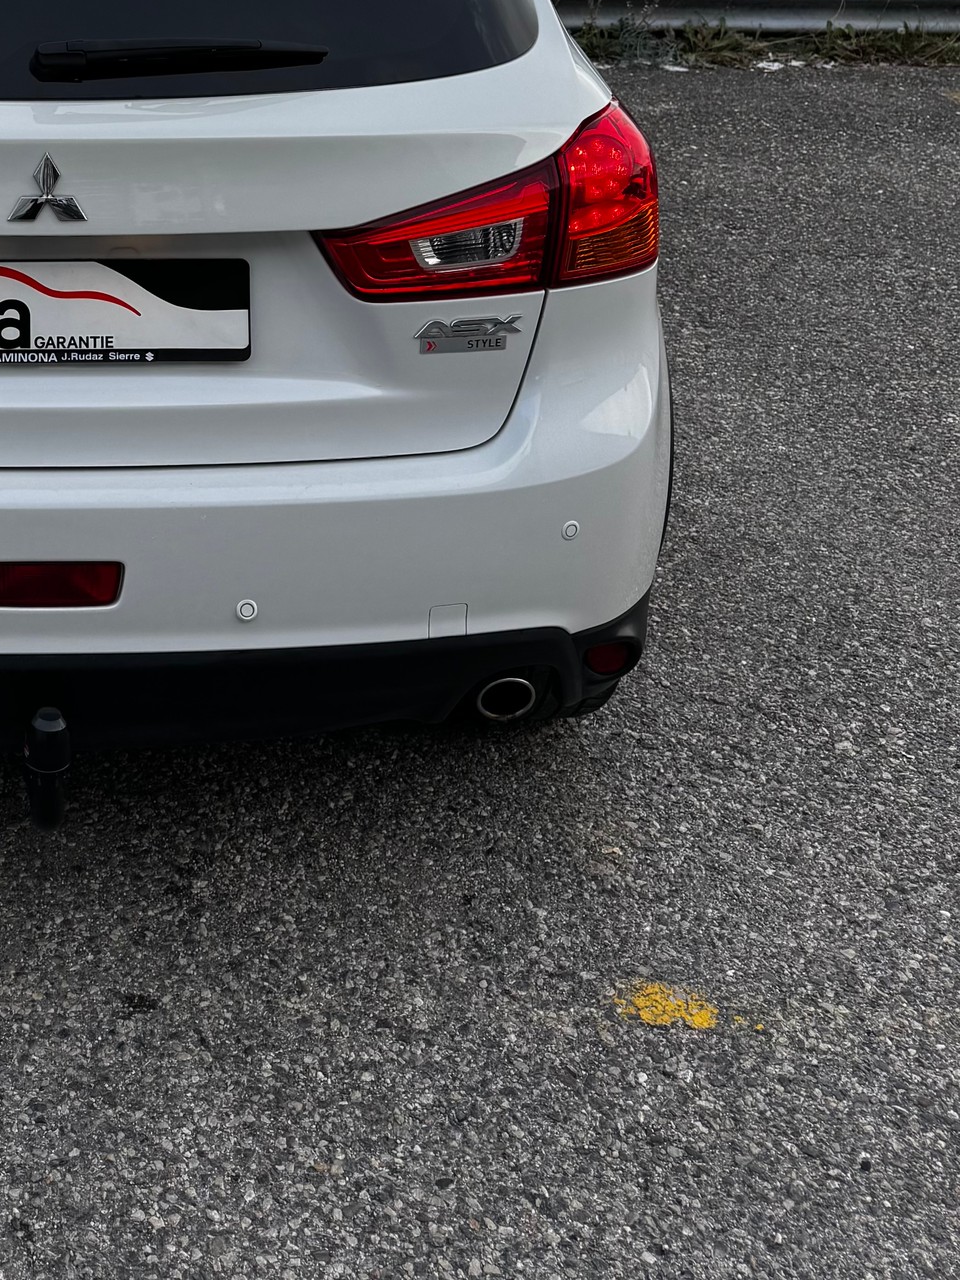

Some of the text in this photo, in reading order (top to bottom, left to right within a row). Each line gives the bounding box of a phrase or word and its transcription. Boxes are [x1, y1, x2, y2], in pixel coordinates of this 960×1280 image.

[414, 313, 523, 338] ASX
[34, 336, 114, 349] GARANTIE
[467, 338, 502, 349] STYLE
[61, 352, 104, 361] J.Rudaz
[108, 352, 141, 361] Sierre
